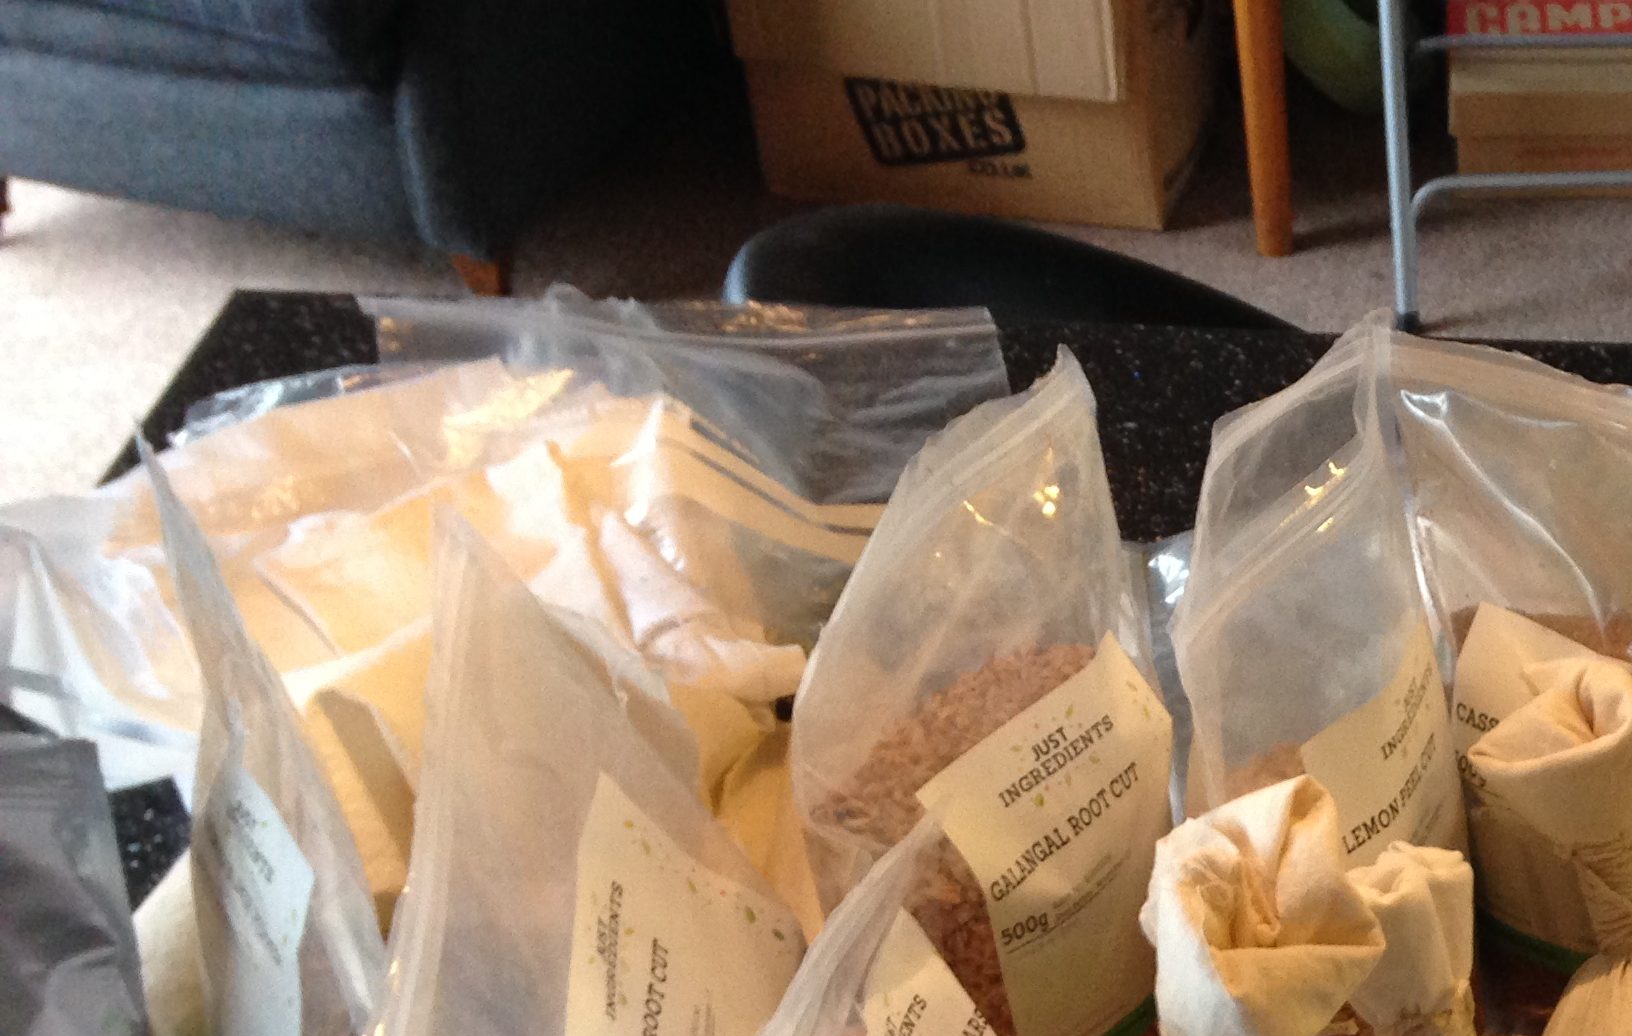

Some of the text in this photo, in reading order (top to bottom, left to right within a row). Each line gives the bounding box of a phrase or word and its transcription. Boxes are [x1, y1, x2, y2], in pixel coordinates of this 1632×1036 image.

[872, 108, 1014, 157] BOXES
[999, 714, 1115, 808] INGREDIENTS
[1031, 727, 1069, 762] JUST
[991, 826, 1071, 901] GALANGAL
[1067, 789, 1111, 840] ROOT
[1108, 761, 1140, 800] CUT
[1342, 797, 1401, 855] LEMON
[1001, 913, 1050, 946] 500g
[651, 936, 669, 983] CUT
